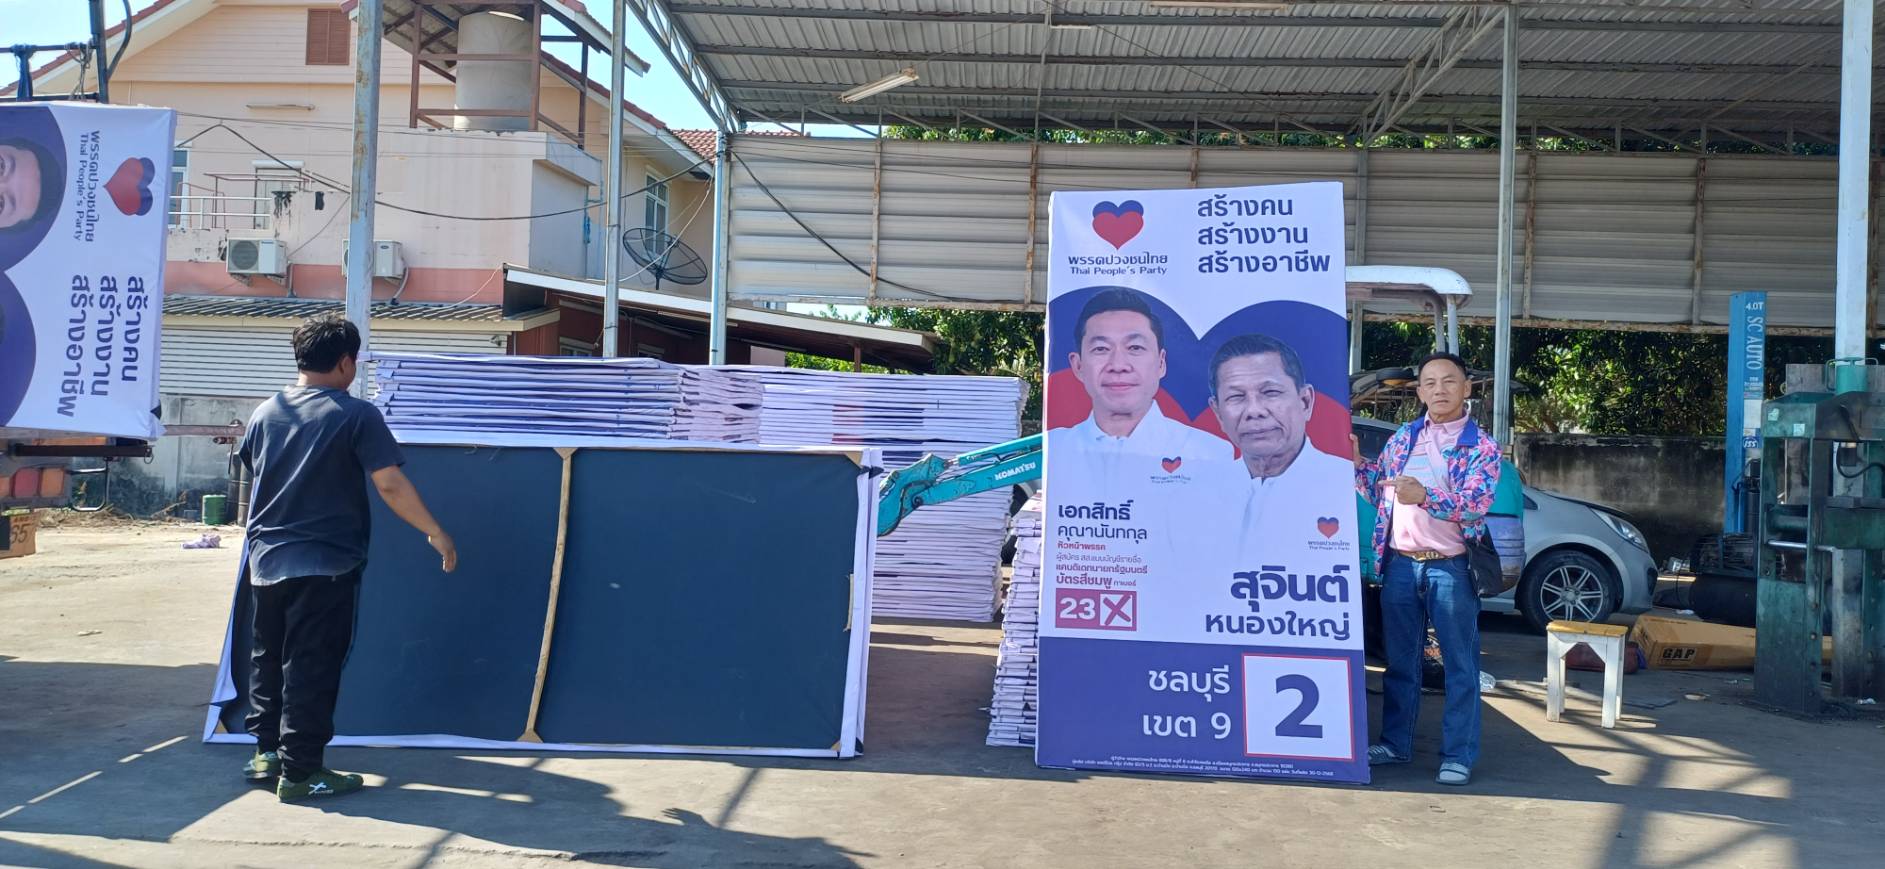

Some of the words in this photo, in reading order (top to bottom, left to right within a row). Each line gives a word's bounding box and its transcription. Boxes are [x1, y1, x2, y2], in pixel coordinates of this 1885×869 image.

[79, 133, 88, 156] Thai
[1197, 193, 1293, 217] สร้างคน
[74, 208, 87, 242] Party
[1197, 222, 1308, 245] สร้างงาน
[1068, 251, 1168, 265] พรรคปวงชนไทย
[1198, 250, 1330, 273] สร้างอาชีพ
[1070, 266, 1090, 275] Thai
[1139, 266, 1168, 275] Party
[121, 276, 148, 382] สร้างคน
[1747, 316, 1764, 332] SC
[57, 275, 92, 417] สร้างอาชีพ
[91, 276, 120, 396] สร้างงาน
[1746, 336, 1764, 370] AUTO
[994, 462, 1036, 480] KOMATSU
[1058, 500, 1134, 520] เอกสิทธิ์
[1058, 524, 1147, 544] คุณานันทกุล
[1056, 572, 1113, 589] บัตรสีชมพู
[1230, 565, 1350, 611] สุจินต์
[1059, 597, 1096, 620] 23
[1206, 610, 1350, 640] หนองใหญ่
[1662, 648, 1696, 660] GAP
[1149, 665, 1230, 702] ชลบุรี
[1275, 674, 1323, 738] 2
[1143, 713, 1197, 738] เขต
[1211, 712, 1232, 739] 9
